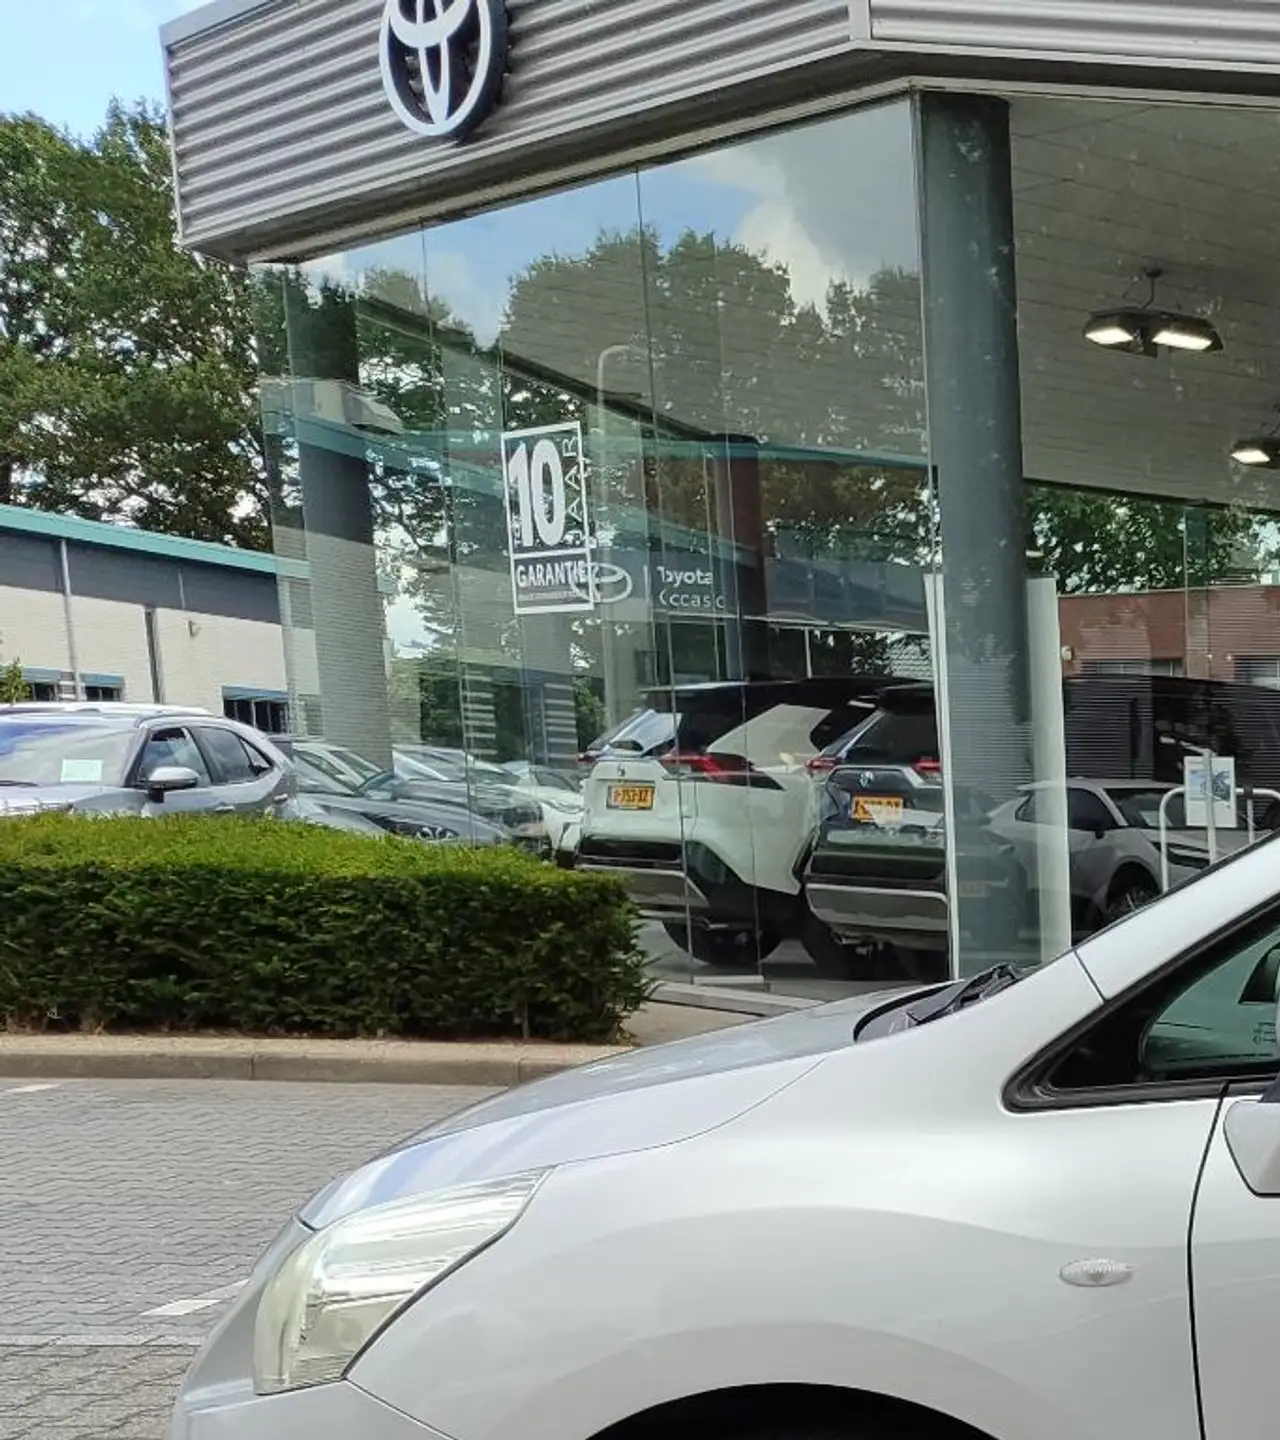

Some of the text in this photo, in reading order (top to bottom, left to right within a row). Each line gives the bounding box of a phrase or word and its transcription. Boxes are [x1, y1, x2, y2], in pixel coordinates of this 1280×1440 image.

[508, 439, 566, 547] 10
[562, 436, 583, 543] JAAR
[517, 560, 586, 588] GARANTIE
